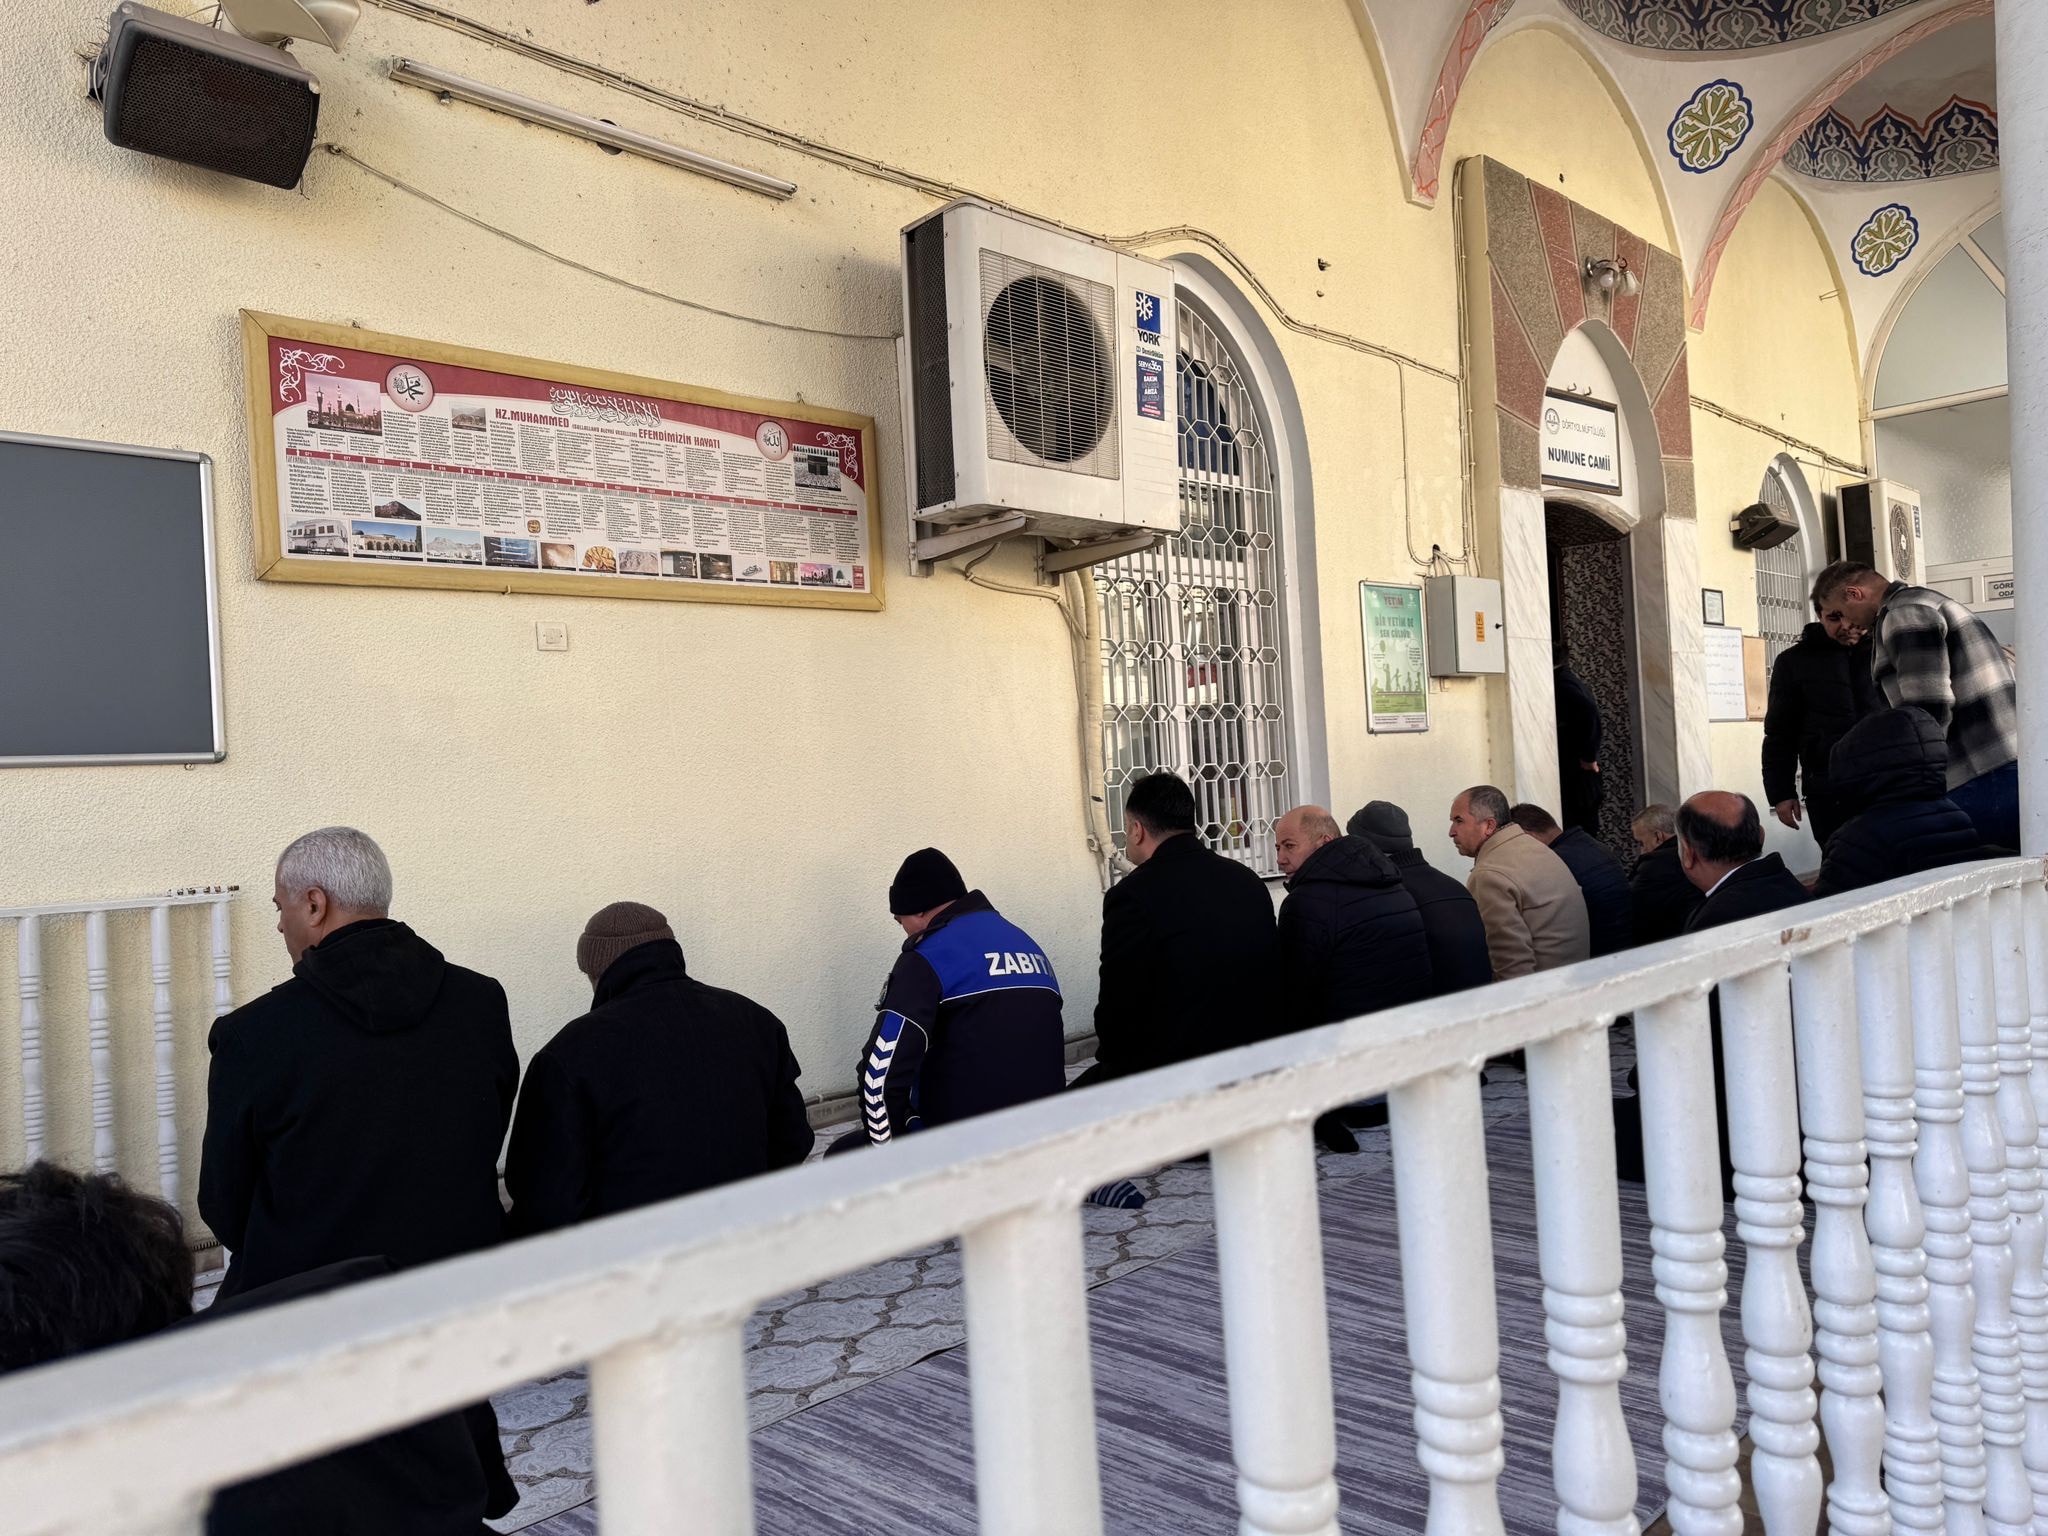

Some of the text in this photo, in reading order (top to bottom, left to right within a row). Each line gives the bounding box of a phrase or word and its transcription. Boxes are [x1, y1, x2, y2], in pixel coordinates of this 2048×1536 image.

[1137, 329, 1161, 346] YORK
[495, 408, 570, 428] HZ.MUHAMMED
[638, 428, 692, 446] EFENDİMİZİN
[694, 438, 720, 449] HAYATI
[1547, 446, 1586, 467] NUMUNE
